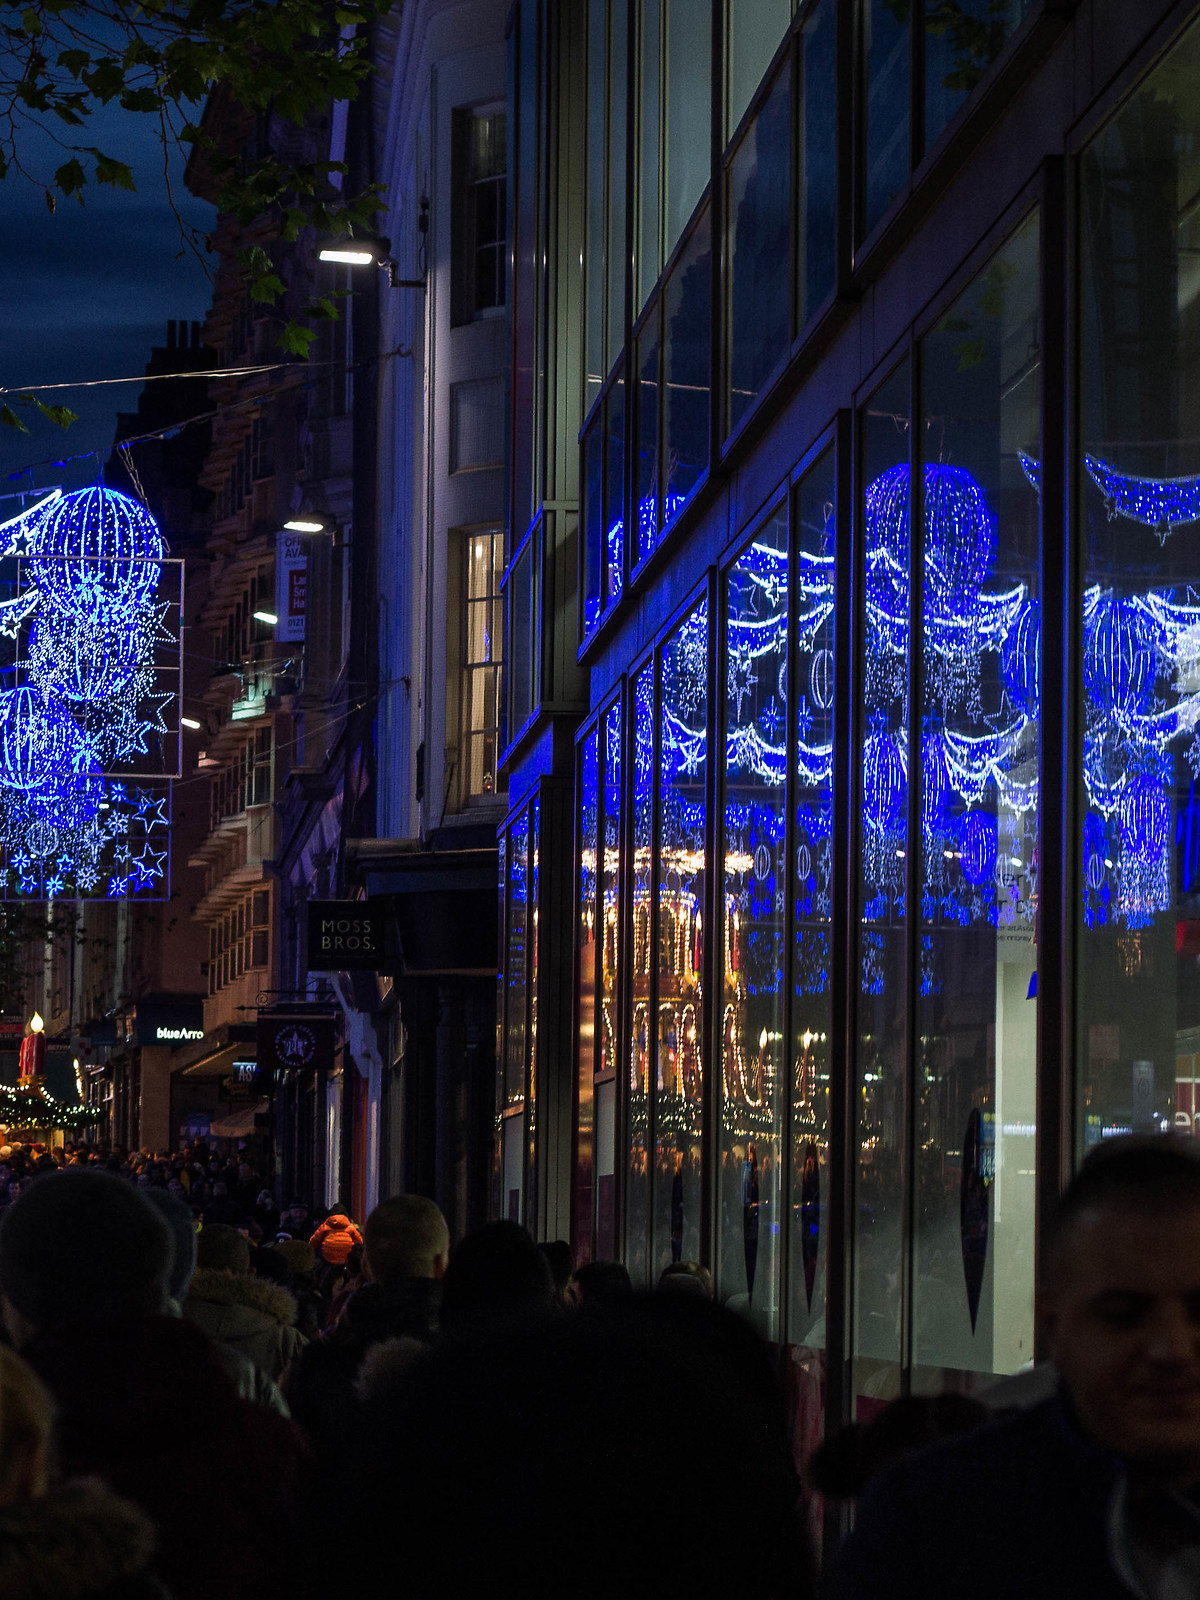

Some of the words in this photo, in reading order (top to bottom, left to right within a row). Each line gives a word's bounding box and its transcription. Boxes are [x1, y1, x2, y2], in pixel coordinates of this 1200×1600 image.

[287, 618, 304, 628] 0121
[321, 919, 371, 933] MOSS
[321, 935, 376, 951] BROS.
